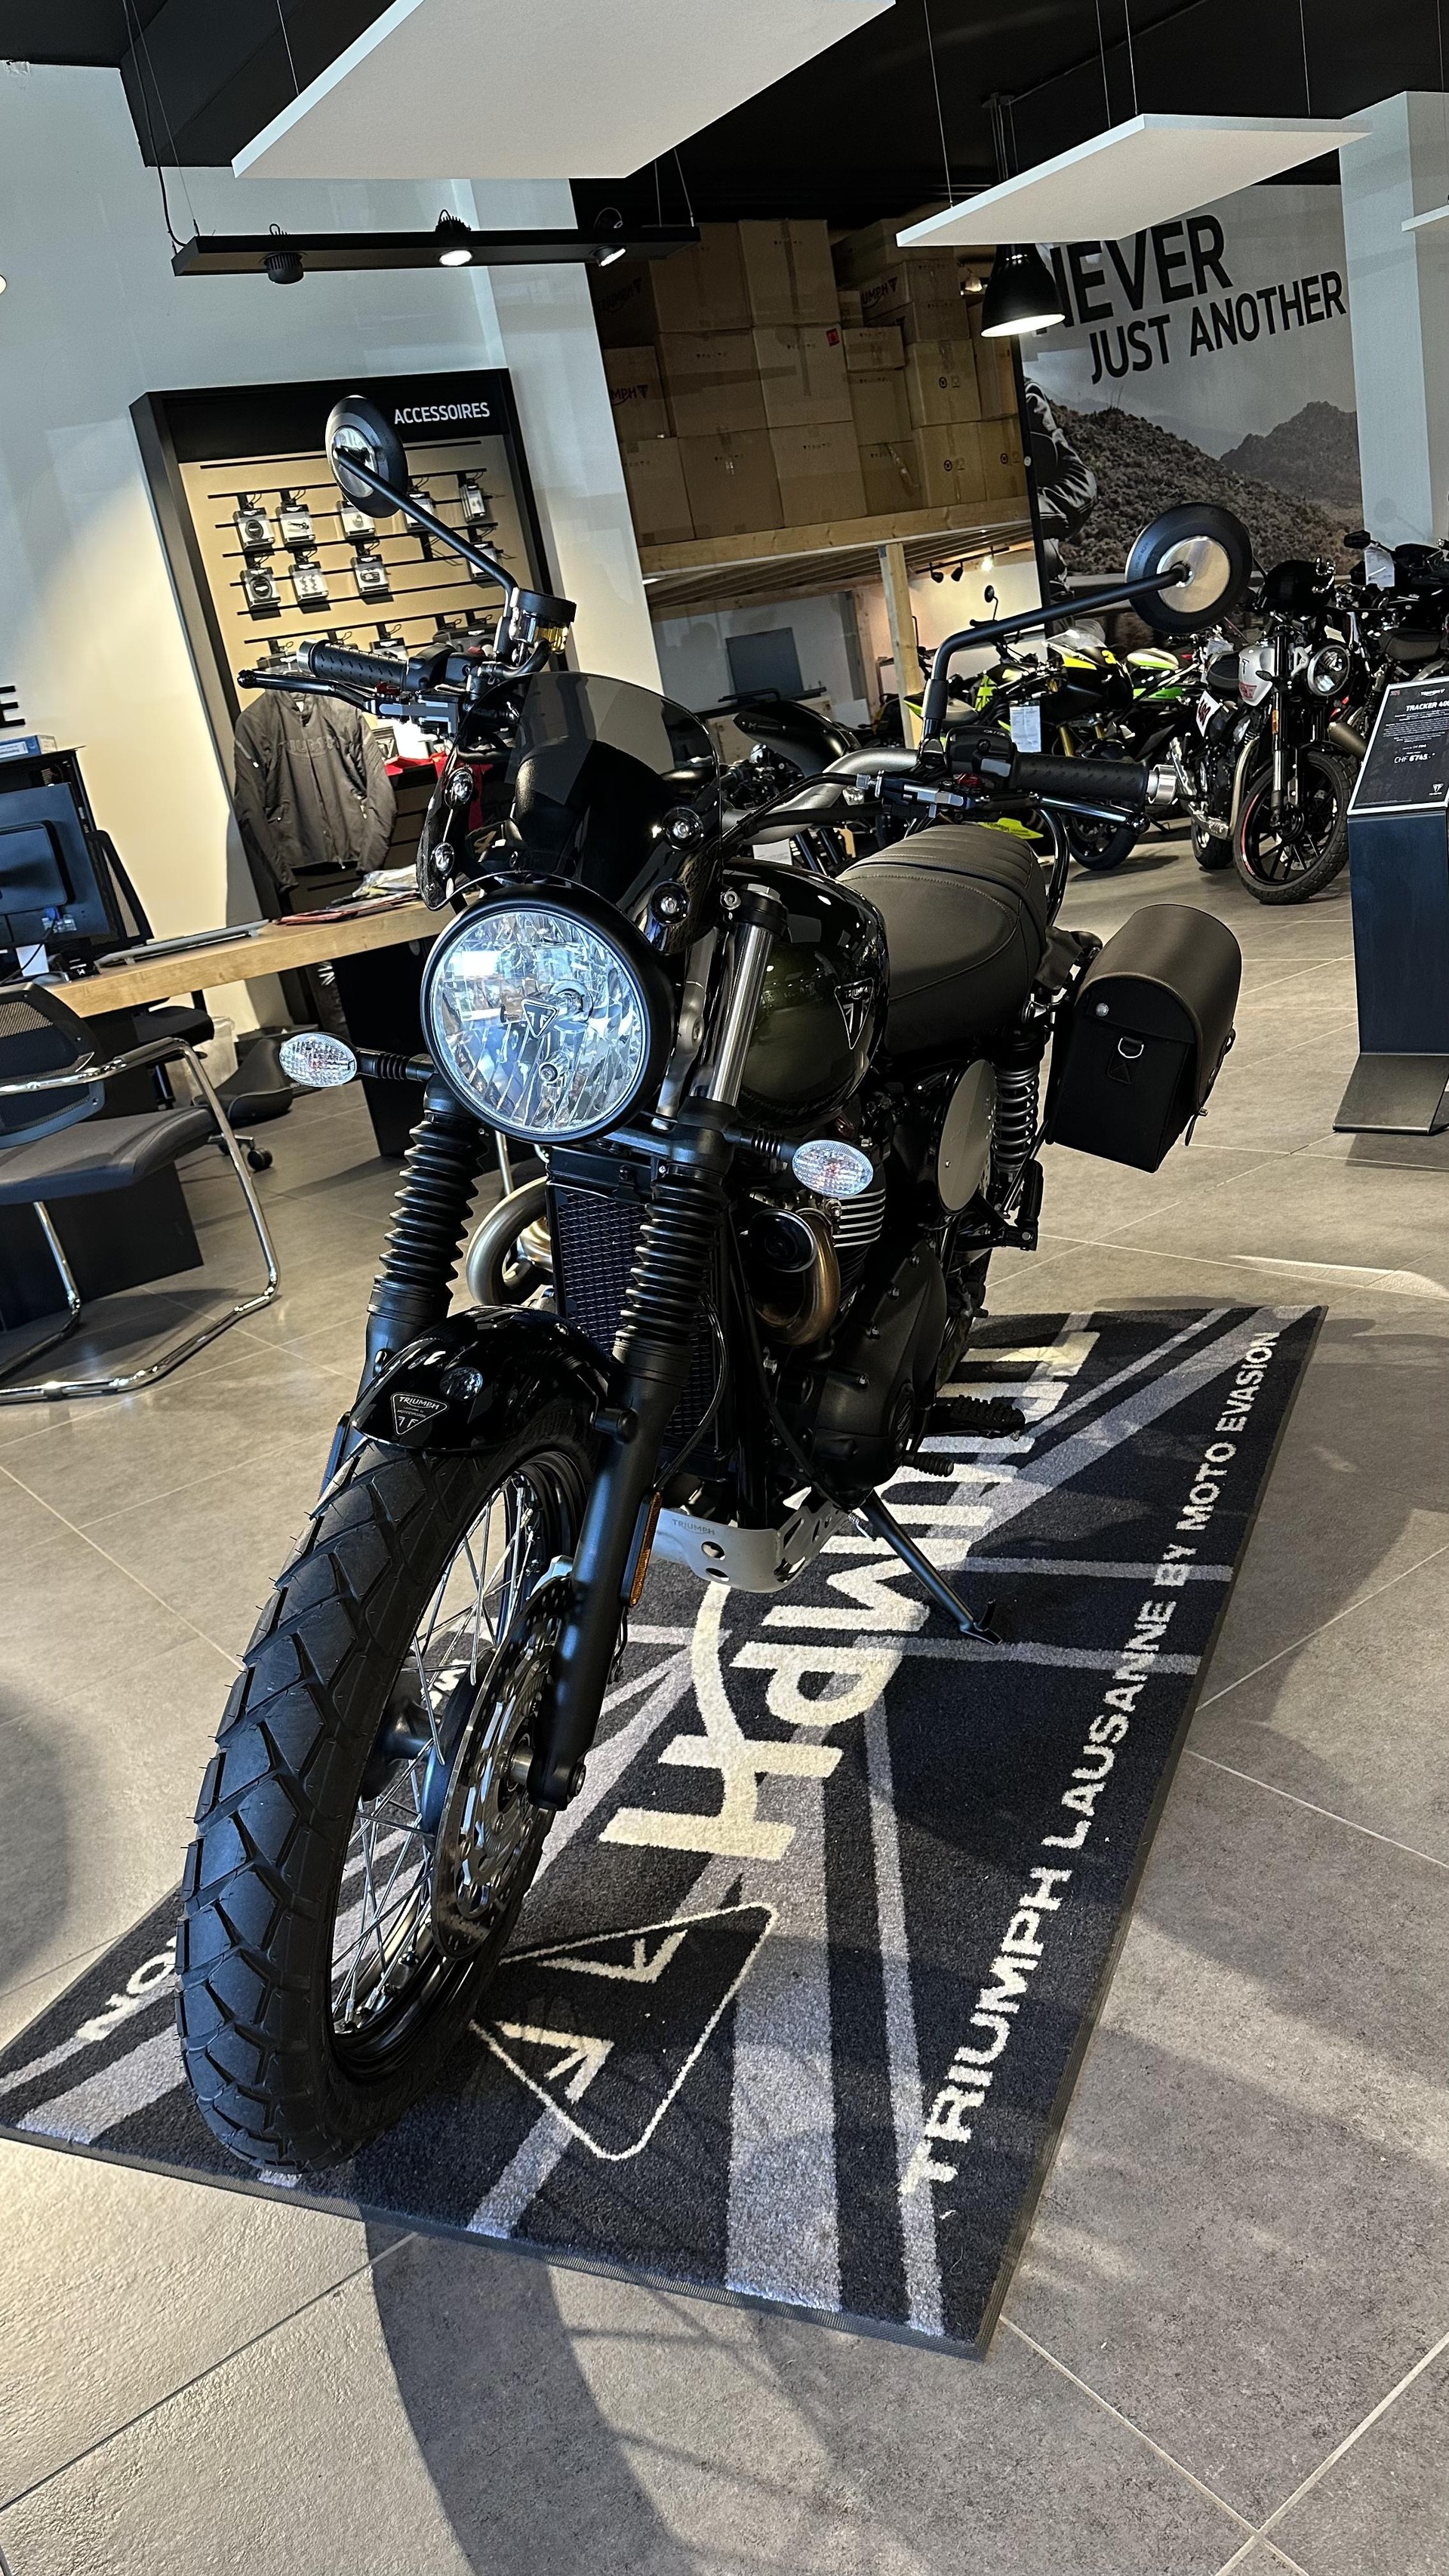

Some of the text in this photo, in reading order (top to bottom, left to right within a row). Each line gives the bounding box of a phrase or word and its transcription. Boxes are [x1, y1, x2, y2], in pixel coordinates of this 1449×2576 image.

[1089, 270, 1347, 385] JUST ANOTHER
[394, 402, 491, 425] ACCESSOIRES
[1406, 702, 1438, 712] TRACKER
[1394, 756, 1409, 764] CHF
[398, 1396, 440, 1410] TRIUMPH
[671, 1519, 716, 1536] TRIUMPH
[899, 1331, 1281, 2196] TRIUMPH LAUSANNE BY MOTO EVASION
